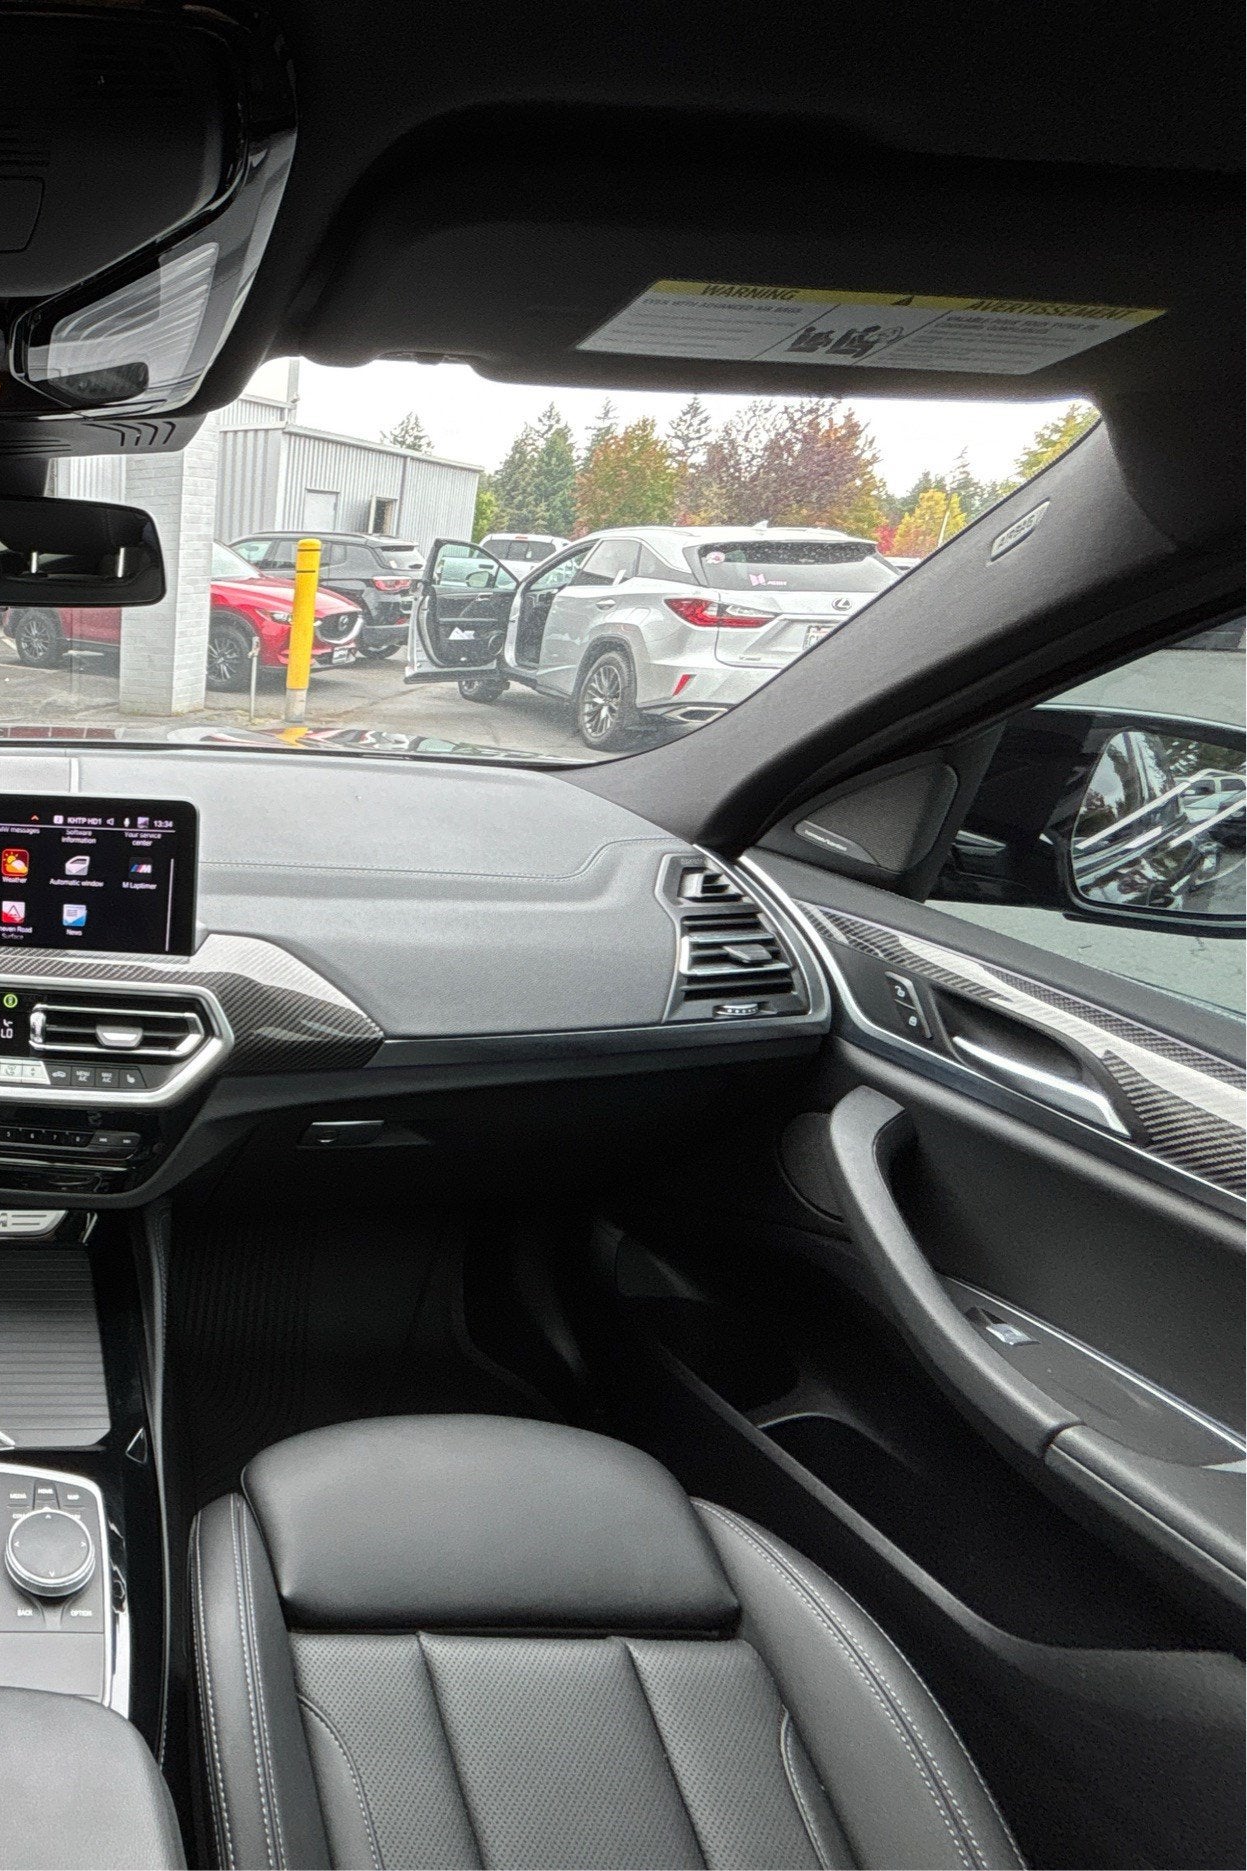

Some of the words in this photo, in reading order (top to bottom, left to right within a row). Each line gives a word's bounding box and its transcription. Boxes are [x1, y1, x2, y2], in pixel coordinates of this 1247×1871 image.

[701, 285, 799, 300] WARNING
[49, 878, 80, 886] Automatic
[1, 1028, 13, 1039] LO
